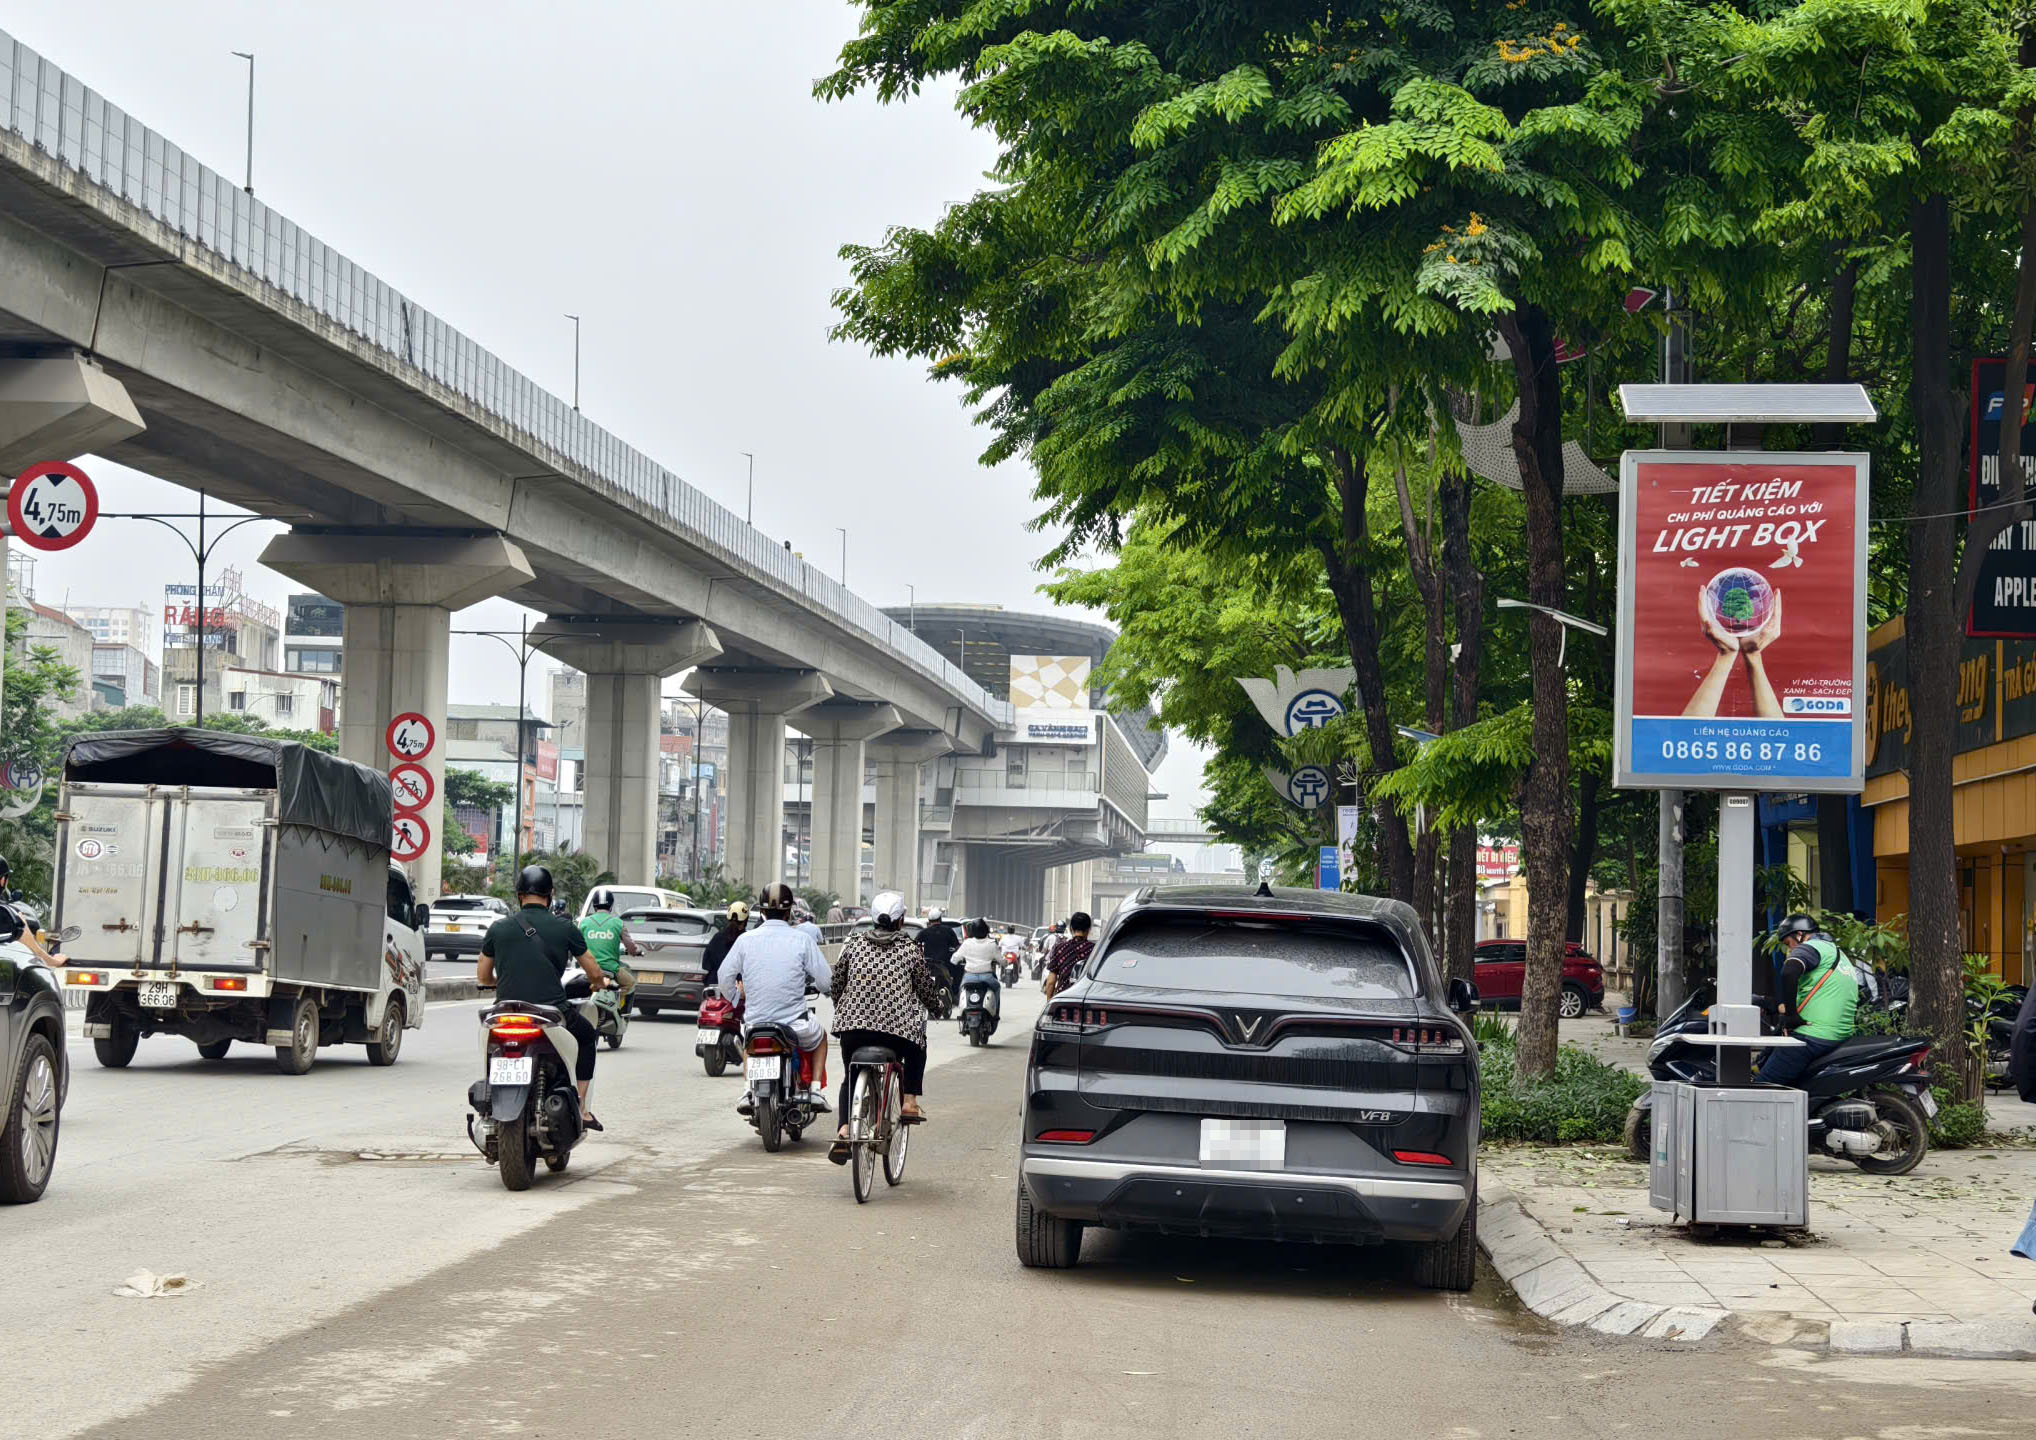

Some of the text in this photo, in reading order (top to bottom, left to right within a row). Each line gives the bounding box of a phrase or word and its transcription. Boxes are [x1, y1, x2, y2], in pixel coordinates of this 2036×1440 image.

[1690, 478, 1803, 504] TIẾT KIỆM
[24, 487, 81, 526] 4,75m
[1667, 501, 1823, 523] CHI PHÍ QUẢNG CÁO VỚI
[1652, 519, 1827, 553] LIGHT BOX
[1994, 577, 2036, 607] APPLE
[1806, 700, 1844, 711] GODA
[397, 728, 424, 749] 4,75m
[1769, 727, 1790, 737] CÁO
[1662, 740, 1821, 762] 0865 86 87 86
[587, 930, 615, 940] Grab
[148, 983, 168, 994] 29H
[141, 994, 175, 1006] 366.06
